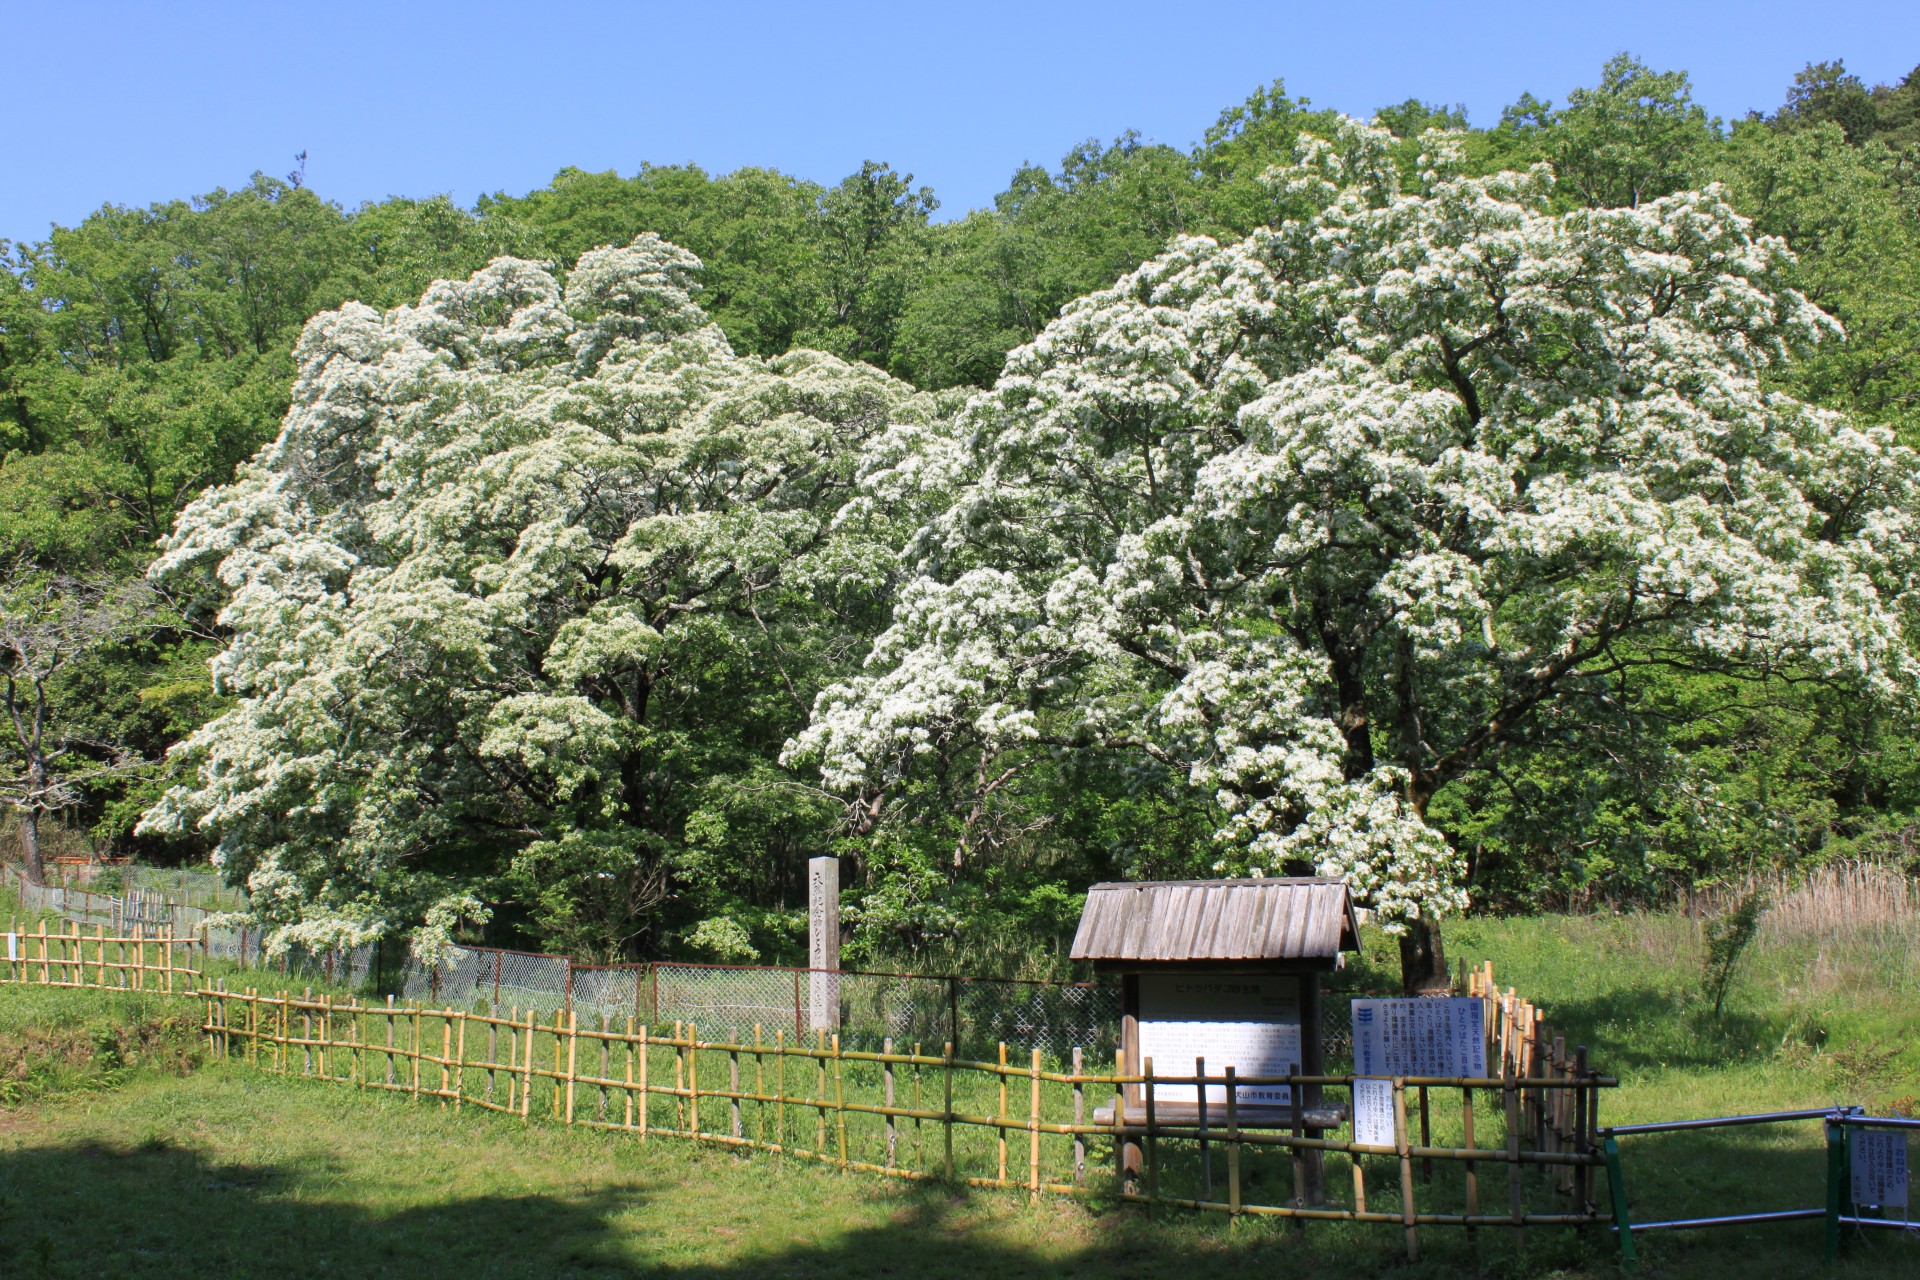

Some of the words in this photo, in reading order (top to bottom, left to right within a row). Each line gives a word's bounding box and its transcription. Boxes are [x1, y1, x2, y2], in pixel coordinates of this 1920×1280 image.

[1175, 983, 1262, 994] ヒトツバタゴ自生地
[1435, 1002, 1445, 1077] ひとつばたごの花や種子
[1470, 1002, 1482, 1070] 国指定天然記念物
[1385, 1095, 1393, 1127] おねがい
[1896, 1148, 1905, 1185] おねがい
